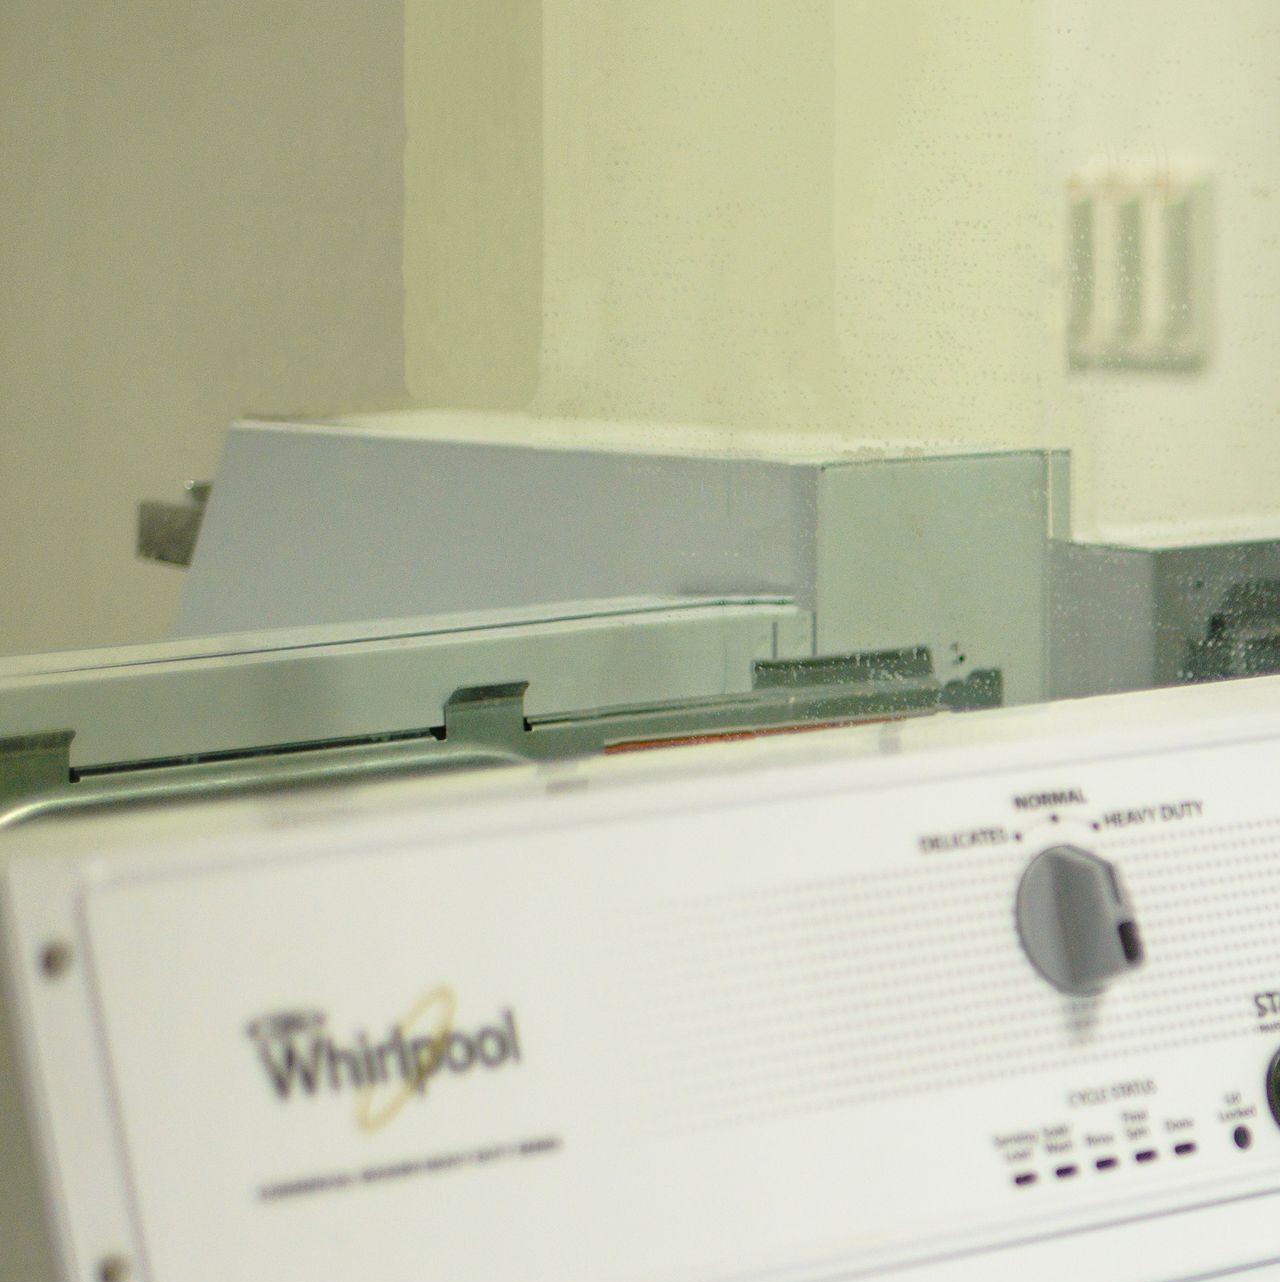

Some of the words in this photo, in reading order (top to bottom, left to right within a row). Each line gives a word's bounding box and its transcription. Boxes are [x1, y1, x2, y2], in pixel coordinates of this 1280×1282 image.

[1013, 789, 1086, 810] NORMAL
[1103, 807, 1157, 828] HEAVY
[1160, 800, 1203, 821] DUTY
[919, 826, 1008, 853] DELICATES
[255, 1006, 521, 1100] Whirlpool
